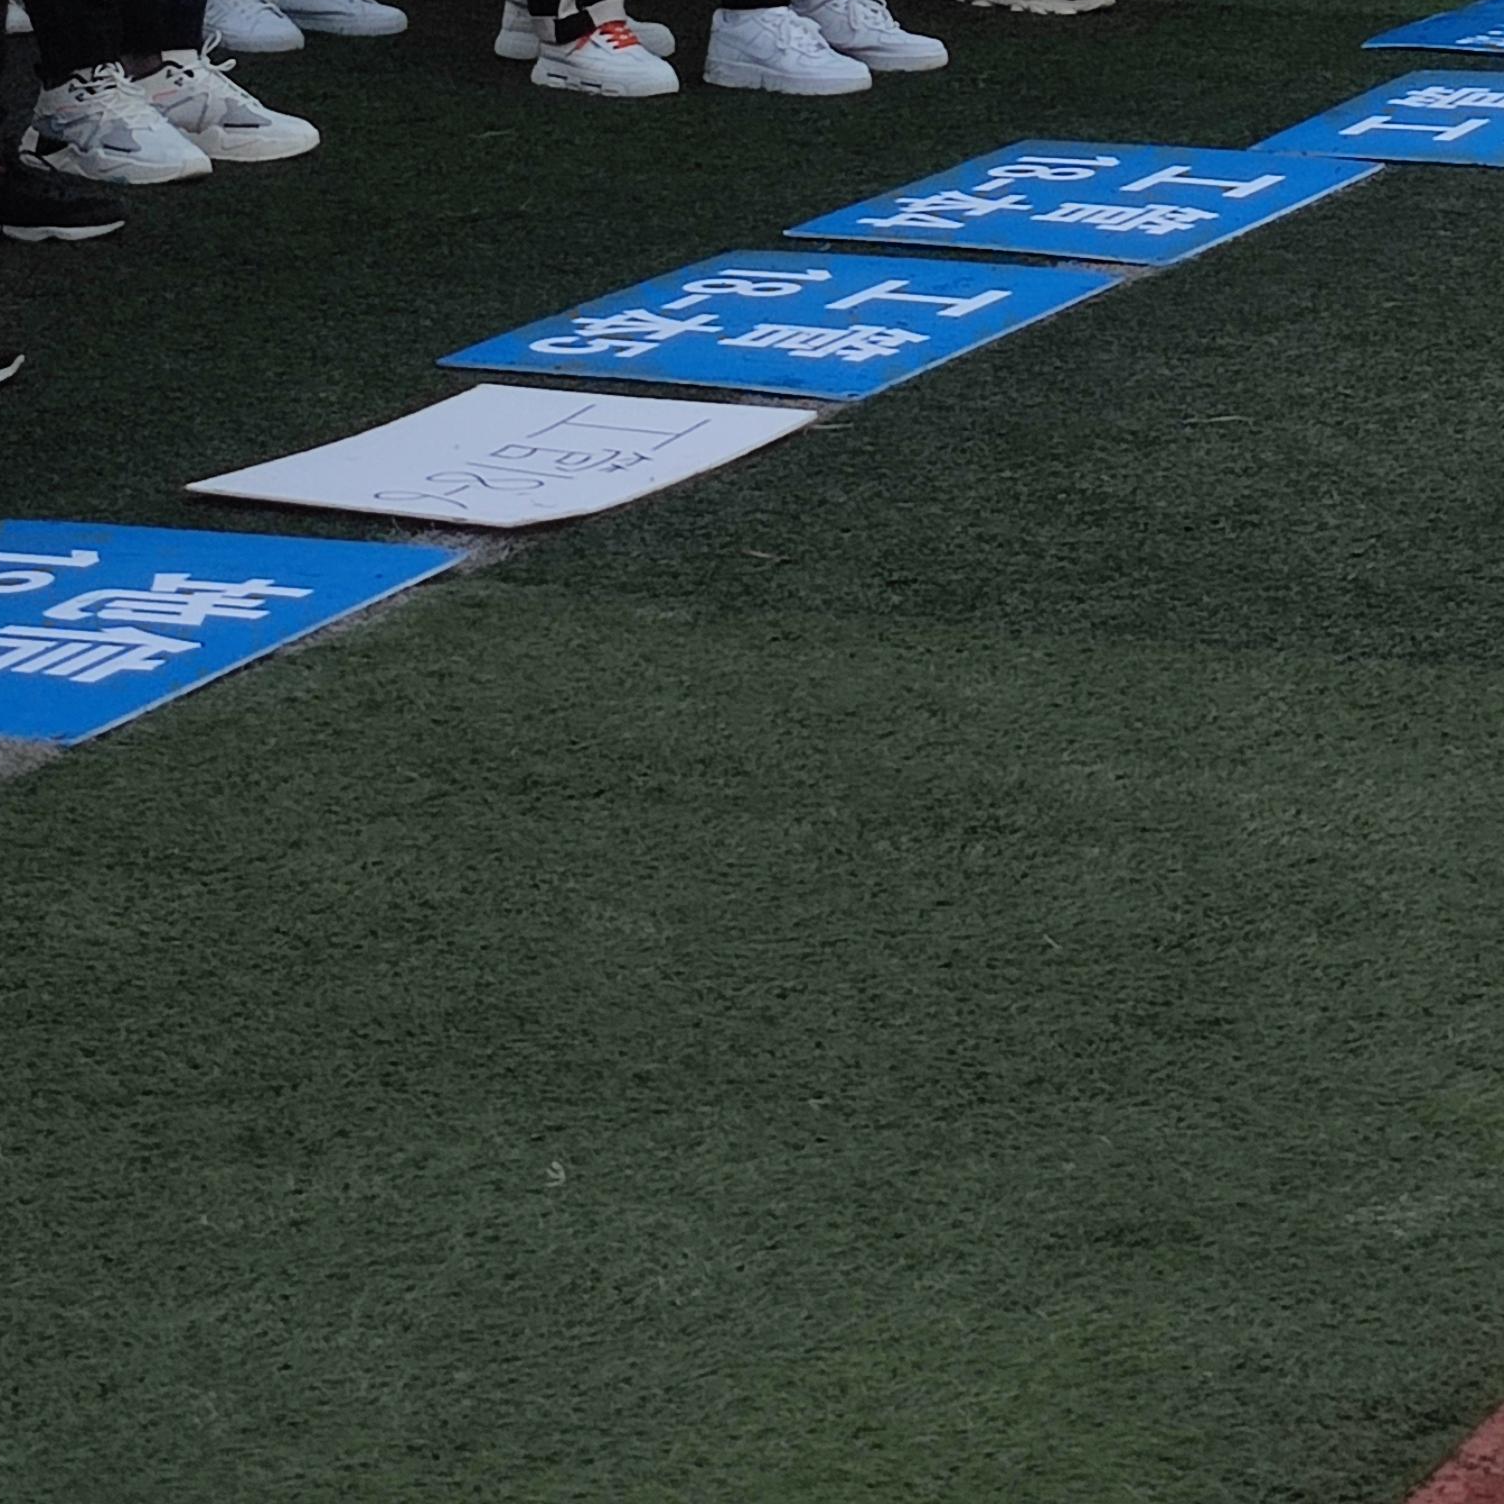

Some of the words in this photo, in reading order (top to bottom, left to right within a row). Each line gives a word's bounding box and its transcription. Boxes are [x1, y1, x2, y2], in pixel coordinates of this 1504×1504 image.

[857, 156, 1120, 229] 18-本4
[1031, 165, 1285, 236] 工管
[528, 268, 832, 360] 18-本5
[717, 278, 1013, 362] 工管
